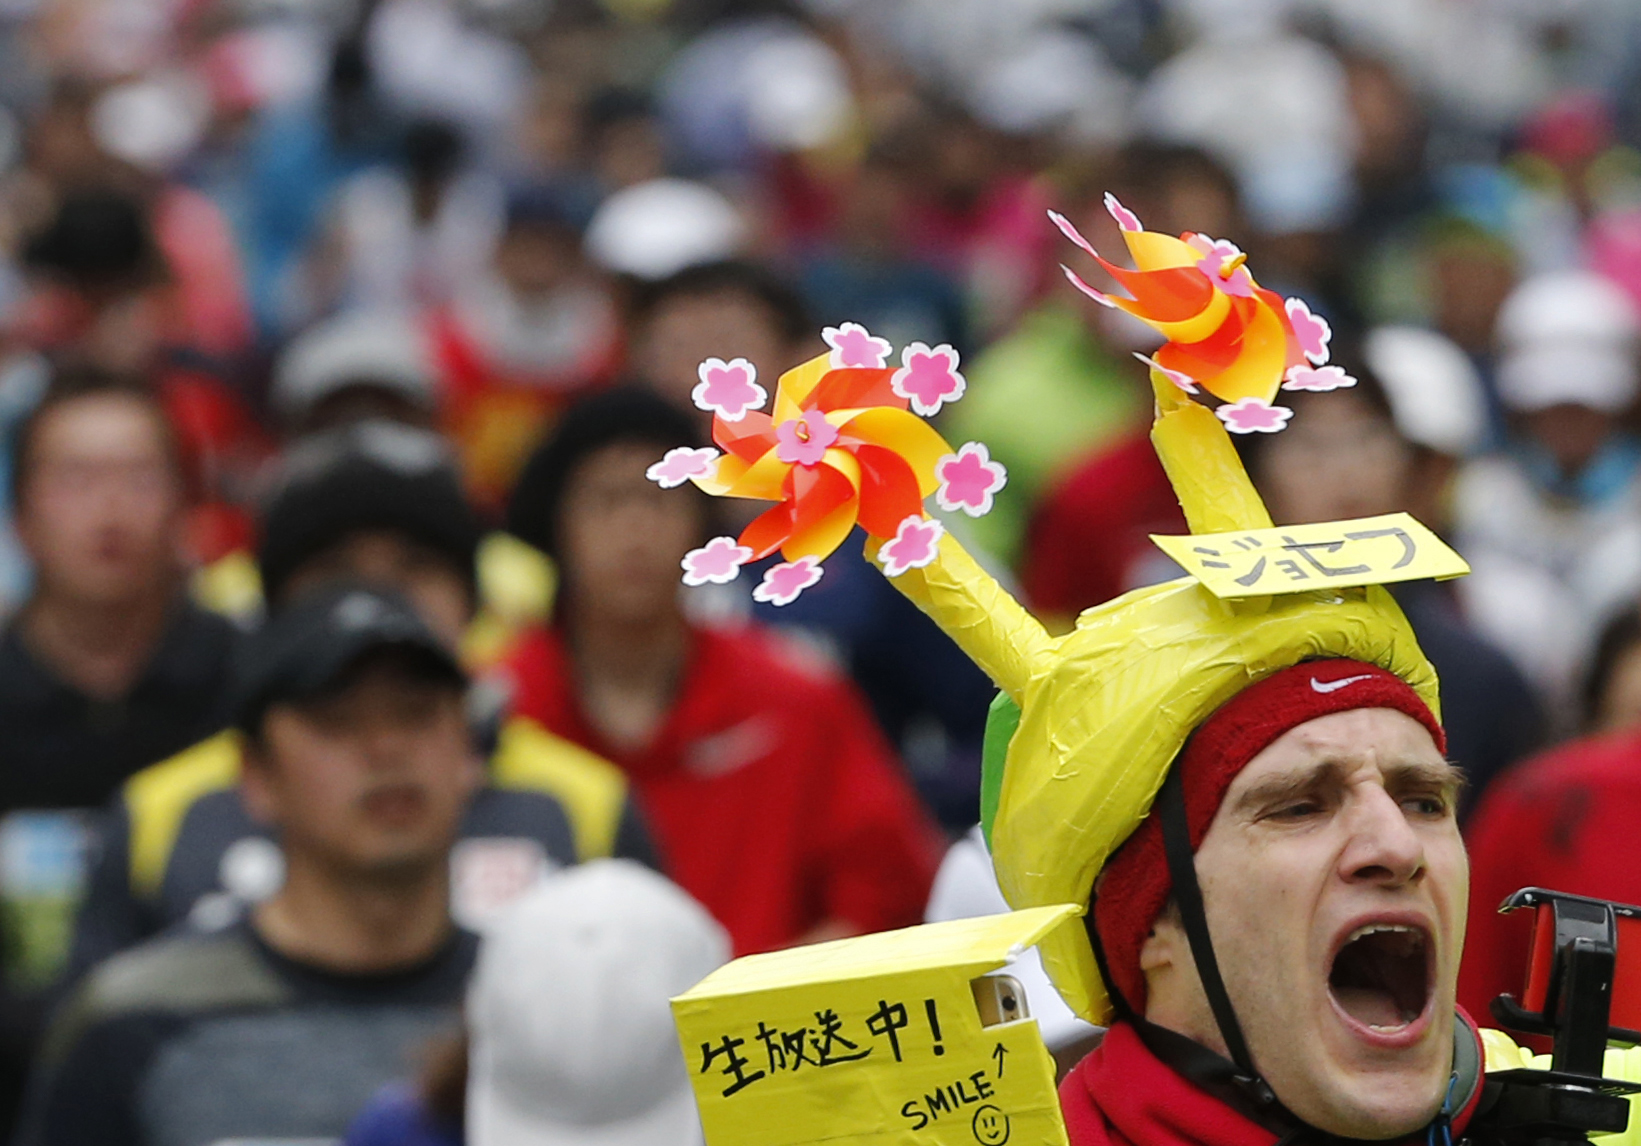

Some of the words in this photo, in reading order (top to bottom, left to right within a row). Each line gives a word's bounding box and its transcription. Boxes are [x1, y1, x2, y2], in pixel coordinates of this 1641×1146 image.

[1194, 527, 1416, 587] ジョセフ
[901, 1071, 995, 1131] SMILE
